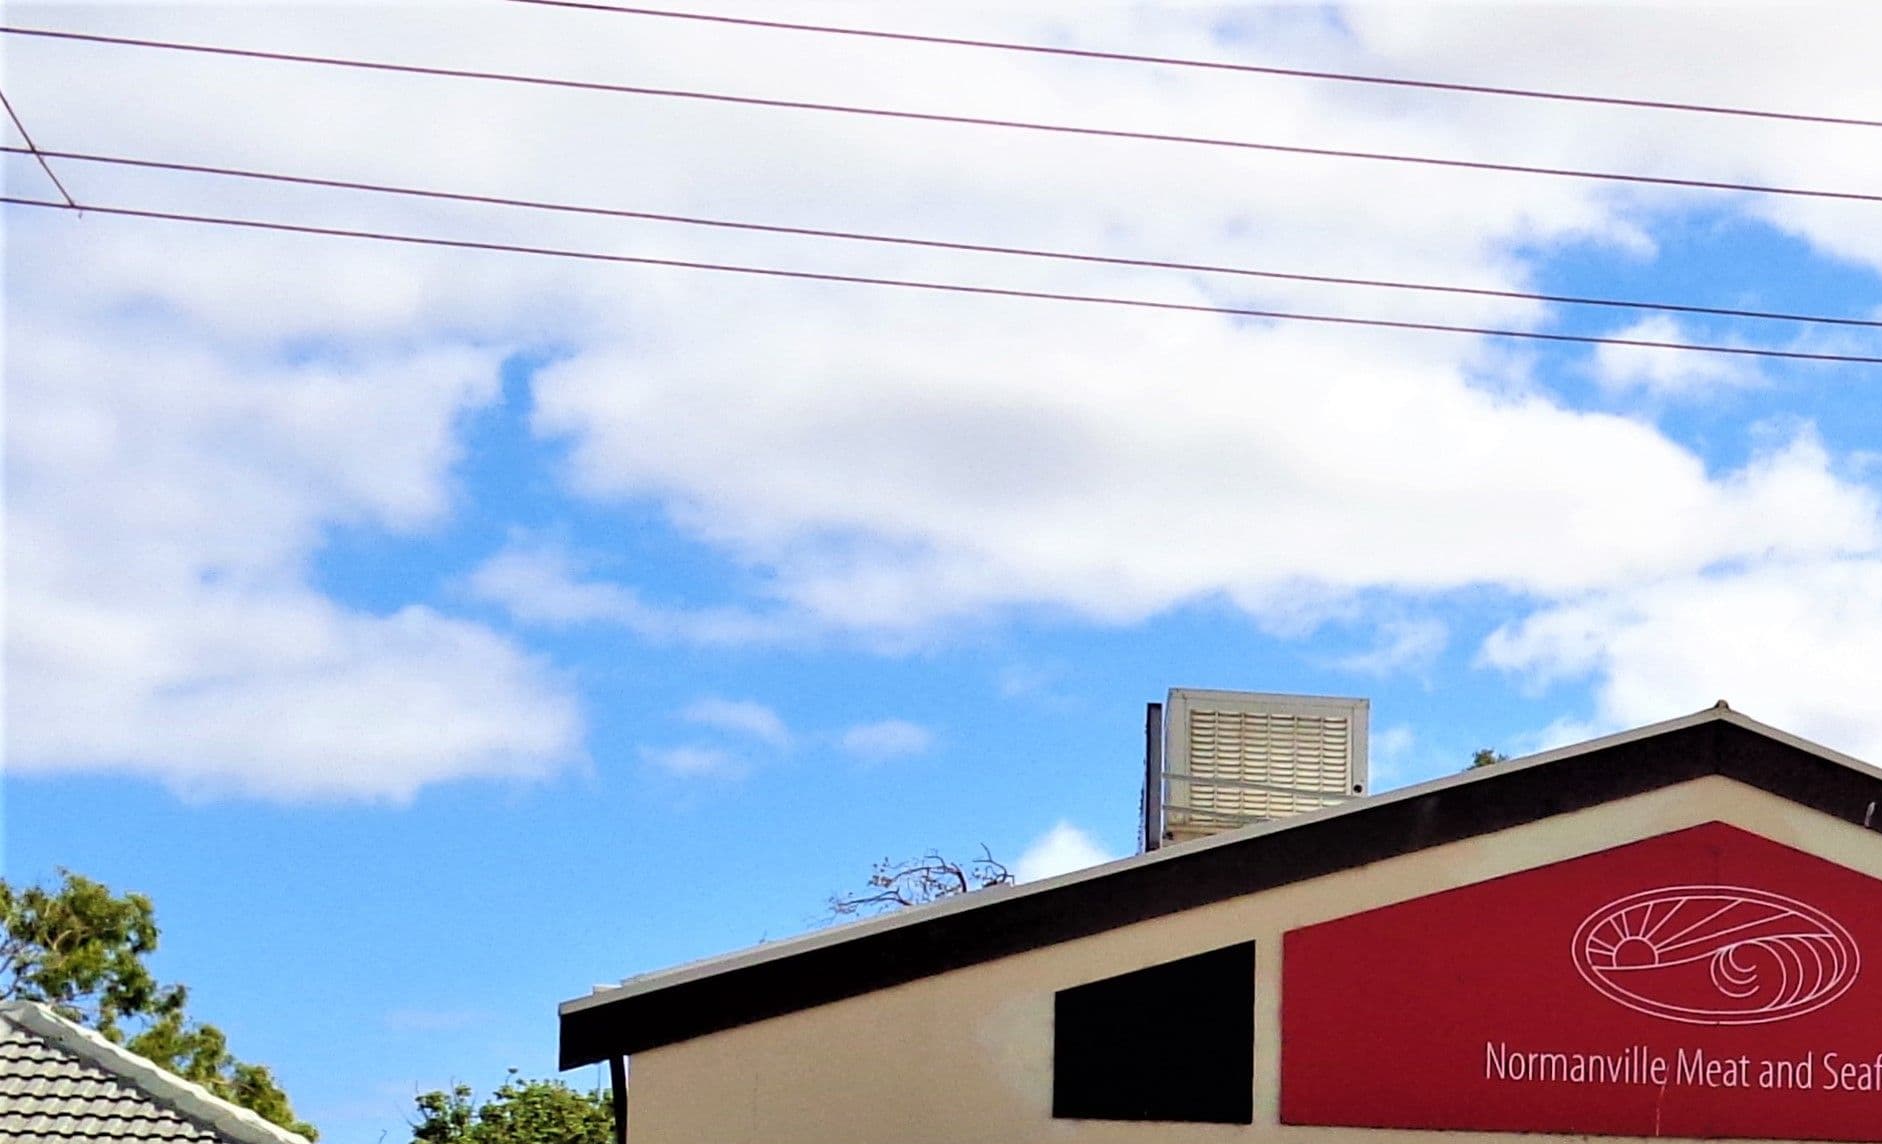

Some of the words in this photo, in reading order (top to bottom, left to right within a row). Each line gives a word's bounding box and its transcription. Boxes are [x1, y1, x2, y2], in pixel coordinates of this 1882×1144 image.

[1485, 1041, 1668, 1086] Normanville
[1675, 1048, 1750, 1089] Meat
[1758, 1052, 1813, 1090] and
